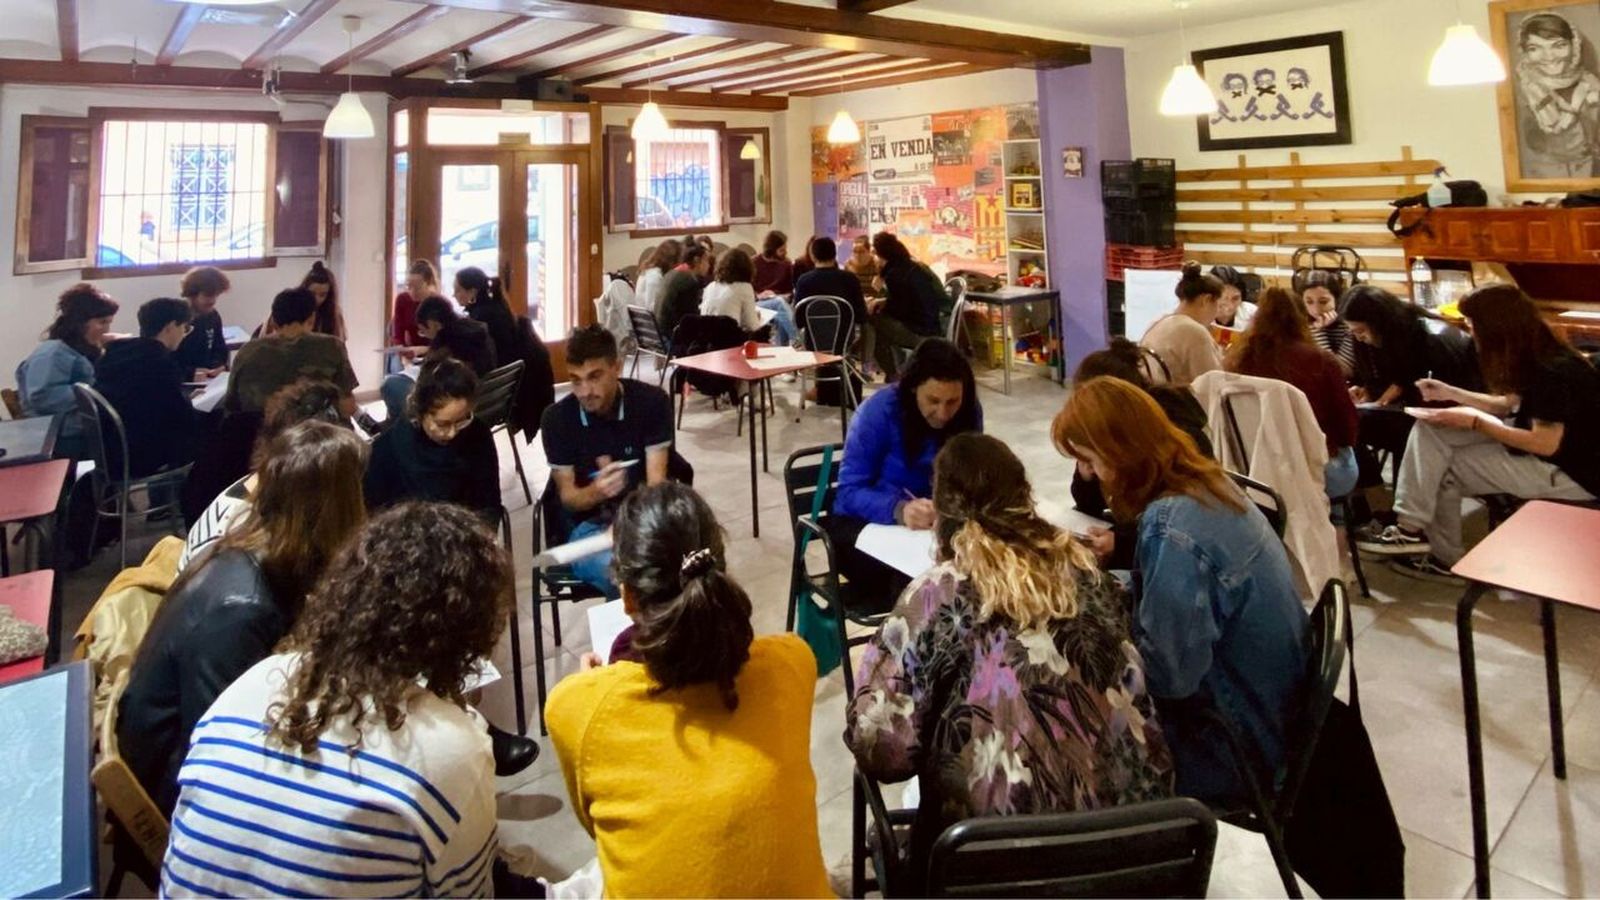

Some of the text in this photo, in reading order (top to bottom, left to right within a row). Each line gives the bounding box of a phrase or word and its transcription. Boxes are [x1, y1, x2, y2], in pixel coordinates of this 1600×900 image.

[870, 143, 886, 160] EN
[890, 138, 934, 158] VENDA
[870, 207, 886, 223] EN
